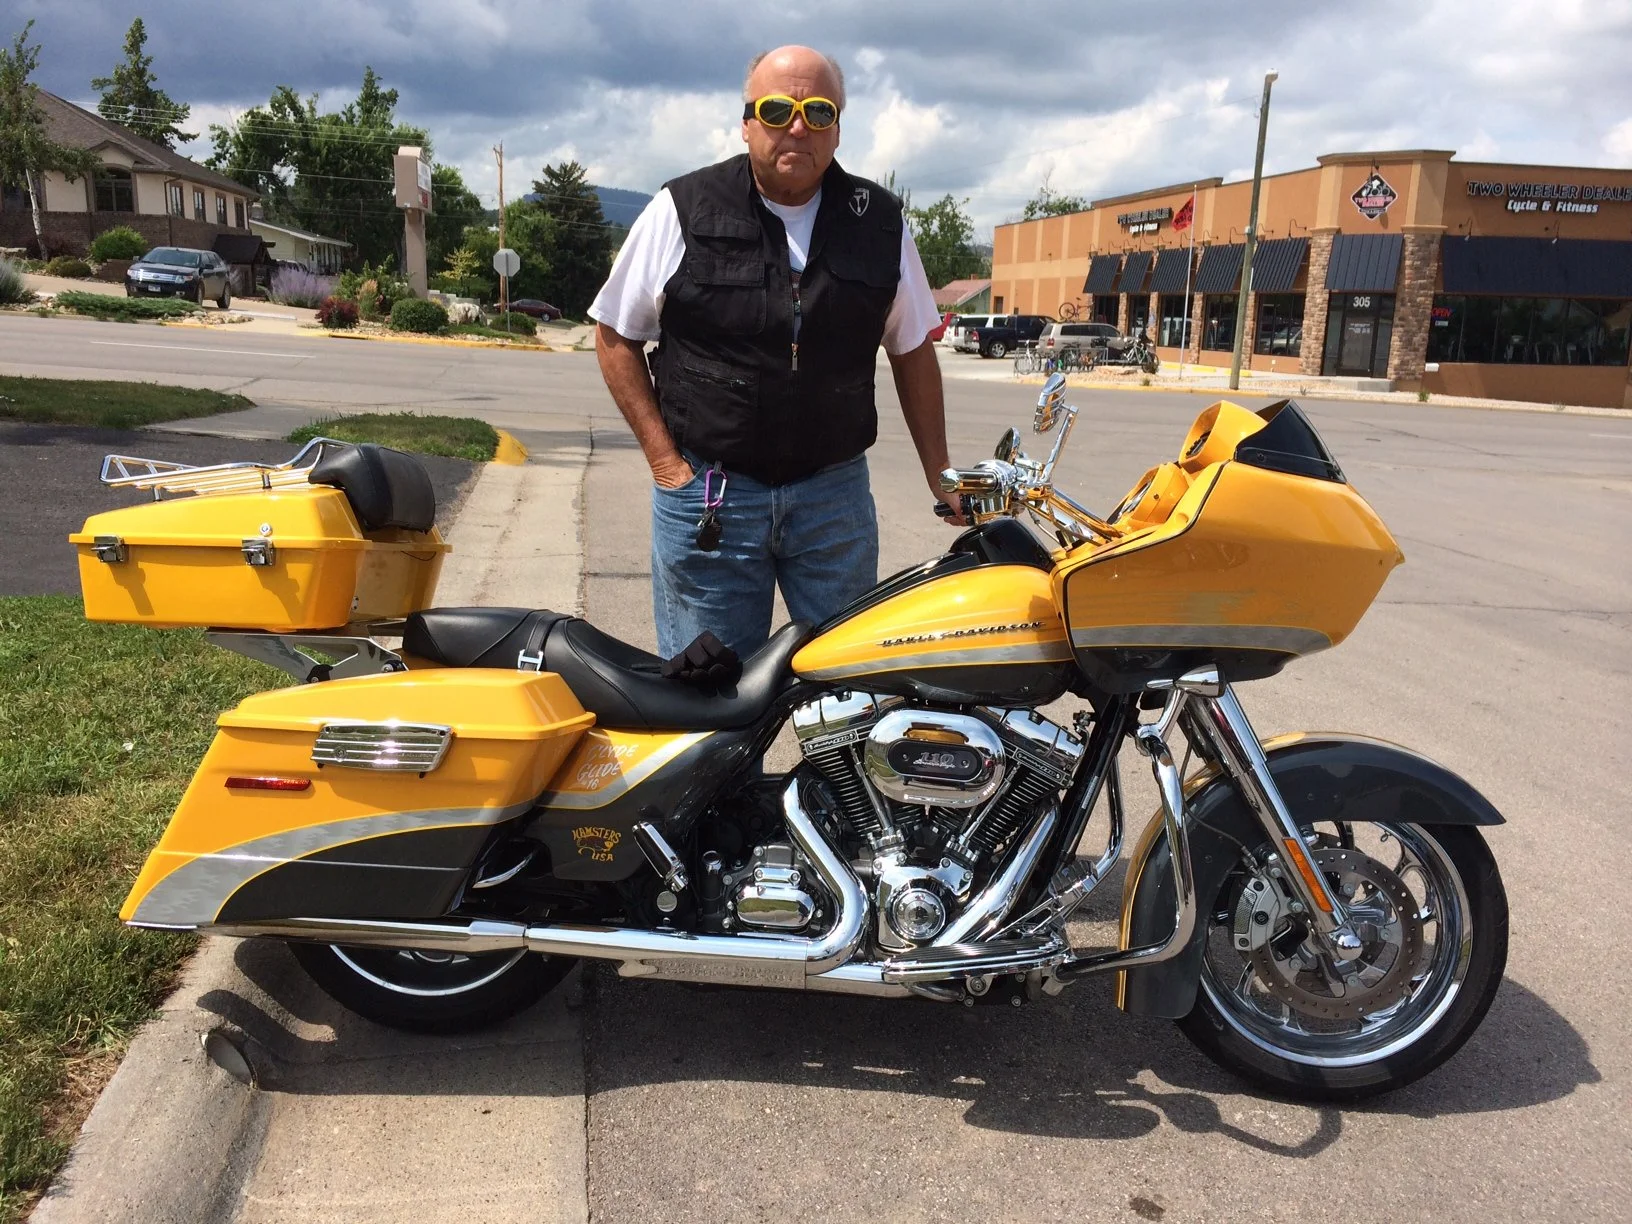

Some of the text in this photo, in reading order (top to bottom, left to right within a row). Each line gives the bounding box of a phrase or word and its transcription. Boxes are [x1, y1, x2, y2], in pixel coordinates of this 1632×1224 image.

[1468, 181, 1504, 196] TWO
[1508, 183, 1579, 199] WHEELER
[1507, 200, 1538, 213] Cycle
[1556, 201, 1599, 213] Fitness
[1353, 296, 1371, 308] 305
[577, 761, 624, 781] GLIDE
[572, 827, 621, 844] HAMSTERS
[592, 853, 614, 862] USA
